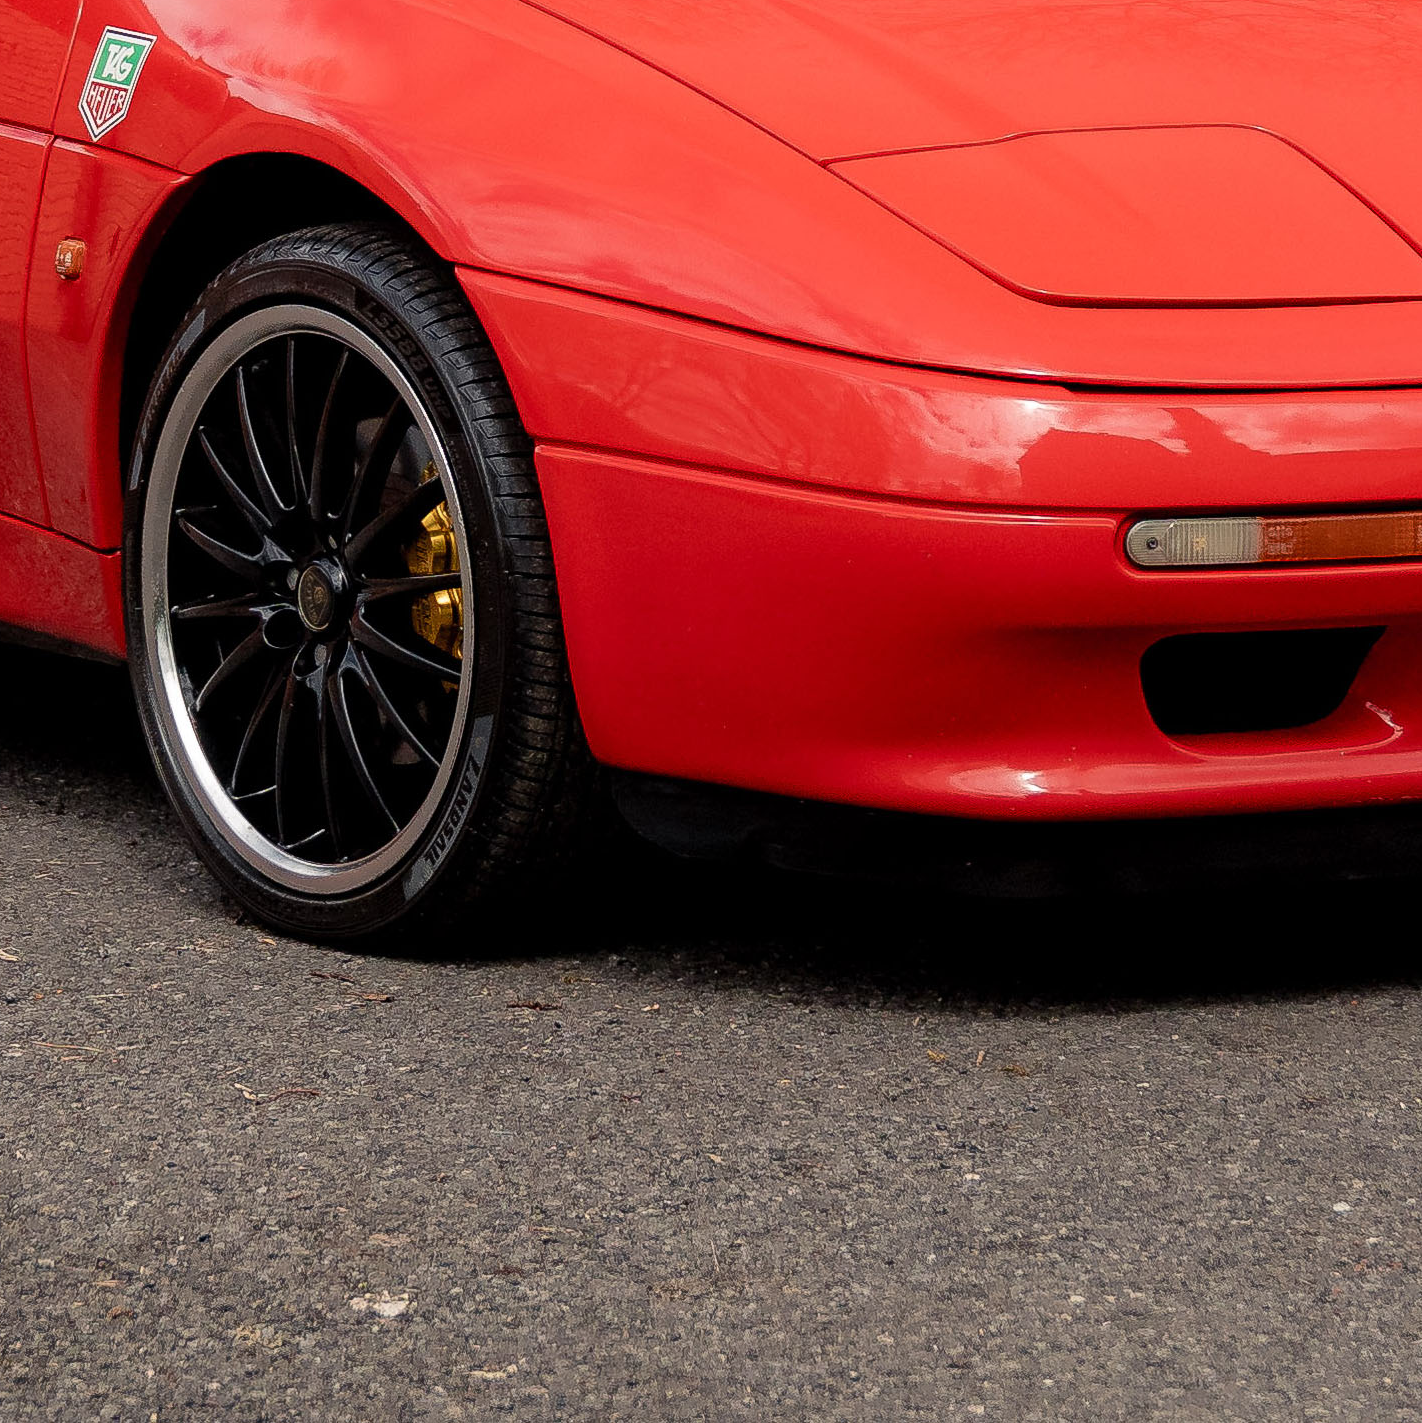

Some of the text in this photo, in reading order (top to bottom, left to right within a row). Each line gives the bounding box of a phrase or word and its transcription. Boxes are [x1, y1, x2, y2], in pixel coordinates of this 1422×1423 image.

[101, 43, 135, 82] TAG
[87, 84, 126, 126] HEUER
[361, 302, 429, 374] LS588
[425, 755, 480, 865] LANDSAIL
